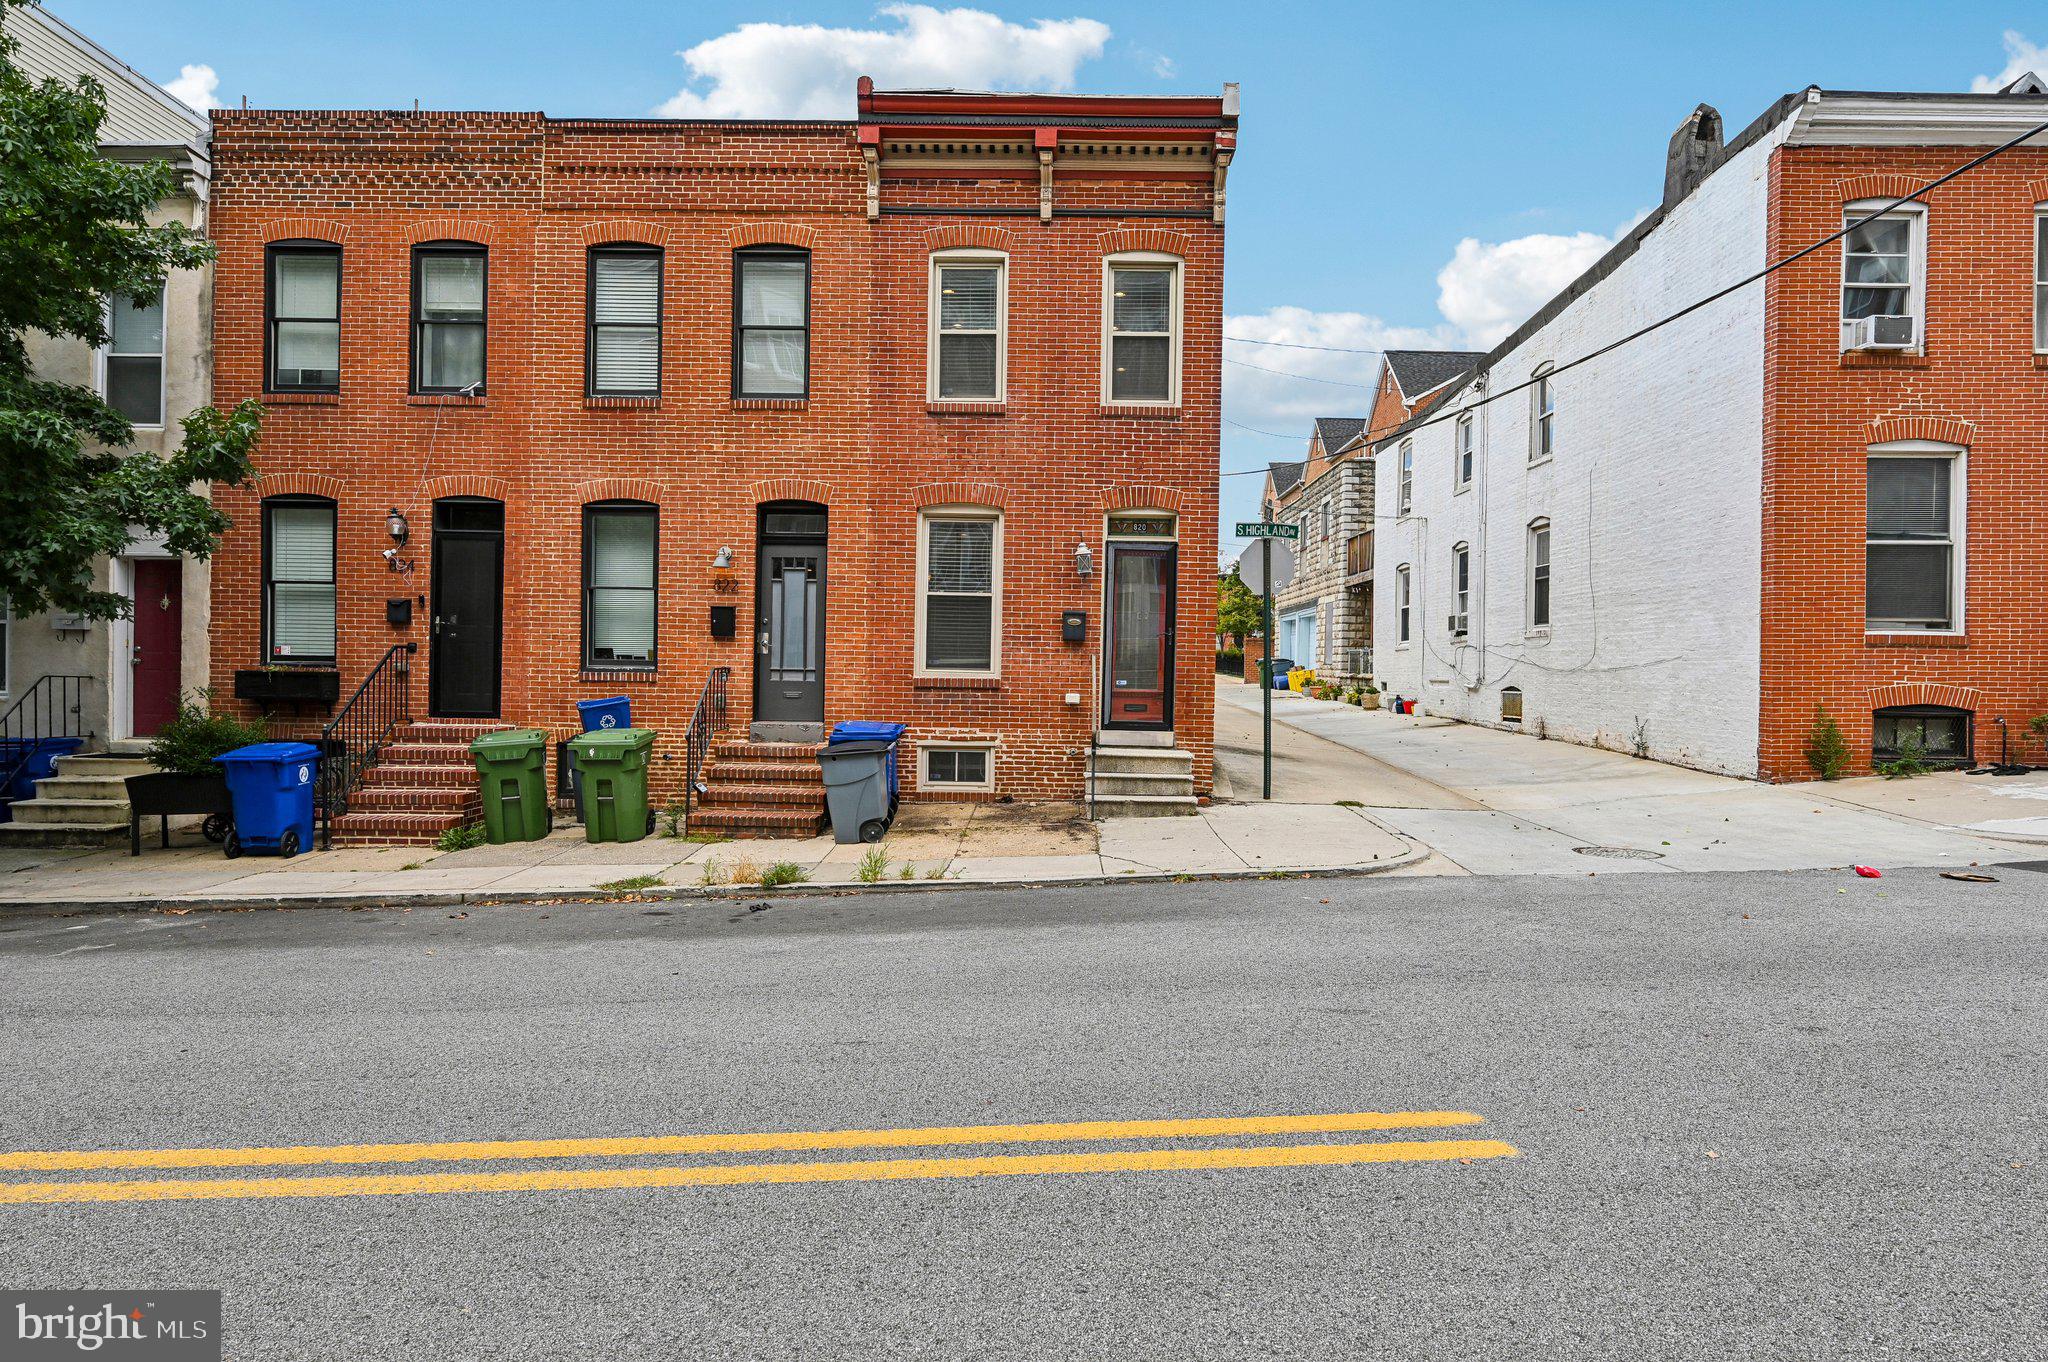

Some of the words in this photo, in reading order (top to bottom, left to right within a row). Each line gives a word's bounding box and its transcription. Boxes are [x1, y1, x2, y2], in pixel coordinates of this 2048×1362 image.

[1133, 523, 1147, 531] 820
[1246, 525, 1290, 537] HIGHLAND
[714, 578, 739, 592] 822
